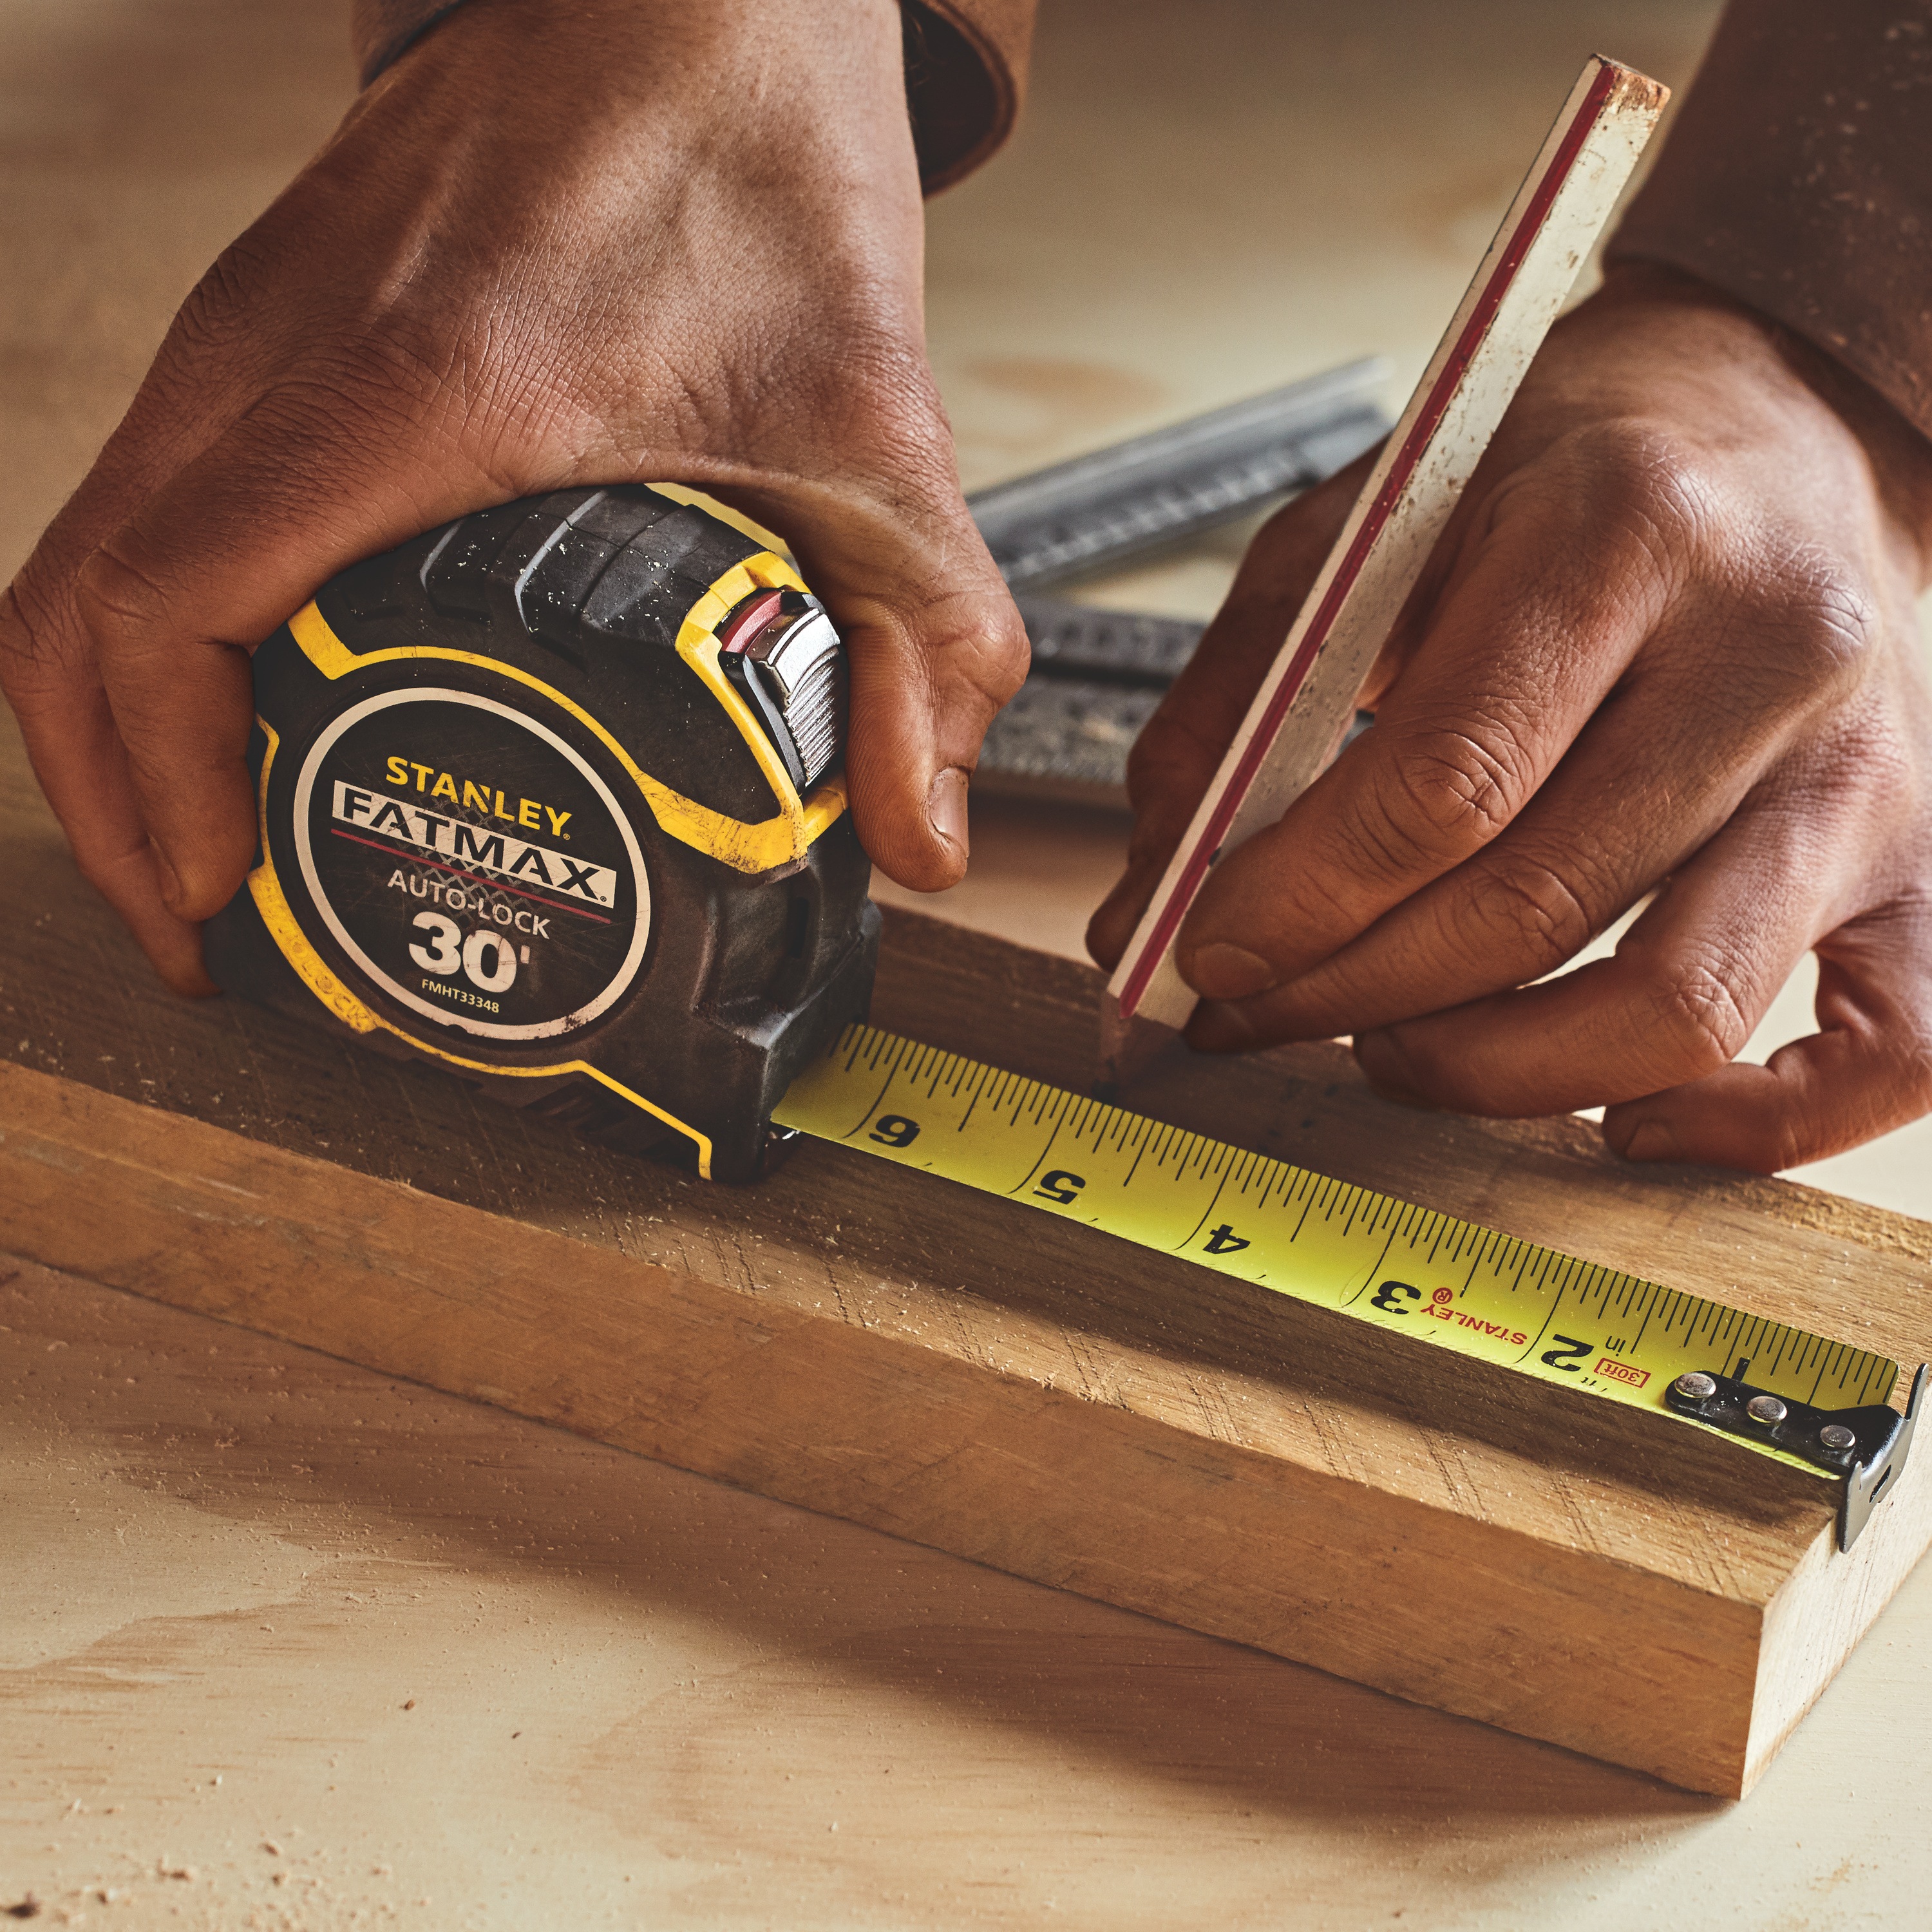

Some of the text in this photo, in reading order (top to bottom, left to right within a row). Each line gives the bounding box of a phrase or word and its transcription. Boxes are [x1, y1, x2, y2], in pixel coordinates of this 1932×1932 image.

[386, 756, 572, 837] STANLEY
[344, 787, 600, 900] FATMAX
[388, 869, 550, 940] AUTO-LOCK
[422, 978, 499, 1013] FMHT33348
[869, 1115, 920, 1147] 6
[1032, 1170, 1086, 1205] 5
[1202, 1224, 1251, 1255] 4
[1370, 1280, 1421, 1315] 3
[1419, 1303, 1527, 1345] STANLEY
[1541, 1334, 1595, 1372] 2
[1605, 1336, 1626, 1357] in
[1604, 1363, 1640, 1382] 30ft
